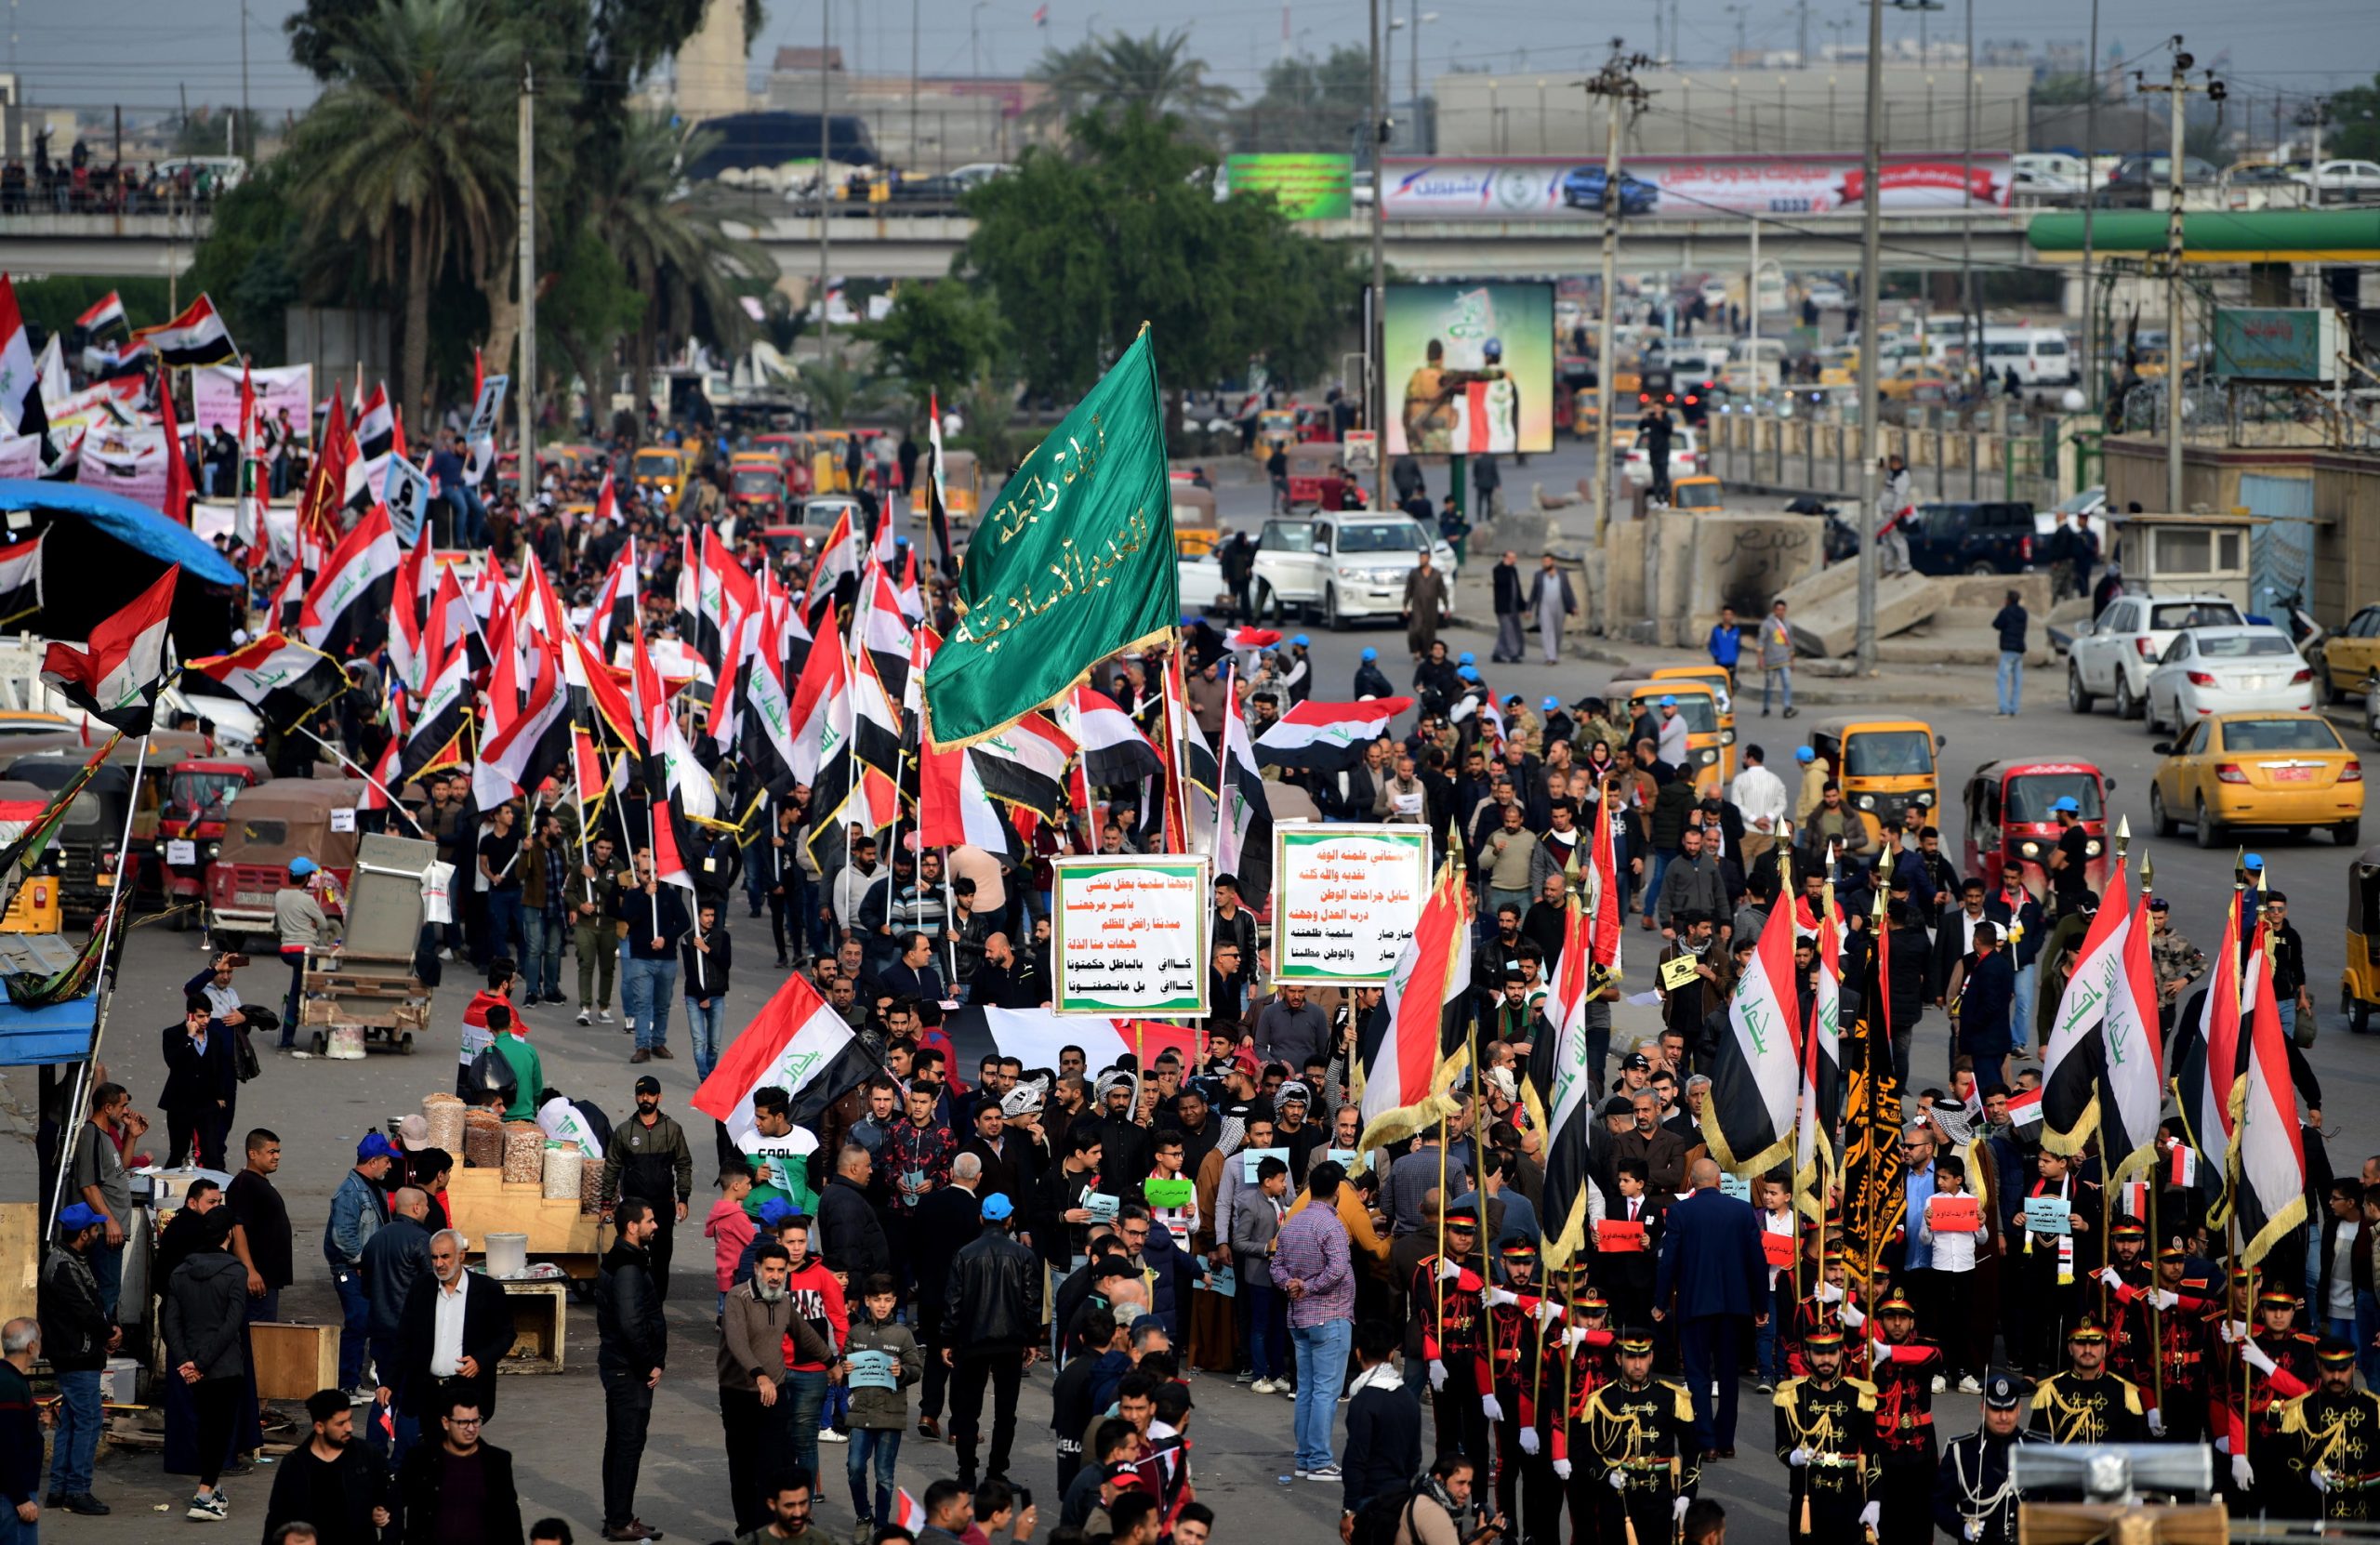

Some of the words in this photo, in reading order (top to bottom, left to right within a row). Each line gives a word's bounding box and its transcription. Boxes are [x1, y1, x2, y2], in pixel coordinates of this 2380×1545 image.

[1320, 868, 1339, 882] والله
[1086, 878, 1111, 894] نمشي
[1114, 879, 1134, 891] بعقل
[1137, 878, 1164, 892] سلمية
[1320, 889, 1347, 903] الوطن
[1350, 889, 1384, 904] جراحات
[1321, 909, 1346, 922] العدل
[1350, 909, 1368, 923] درب
[1102, 918, 1125, 933] للظلم
[1128, 918, 1150, 931] رافض
[1325, 928, 1353, 940] سلمية
[1377, 930, 1394, 941] صار
[1067, 939, 1088, 950] الذلة
[1091, 939, 1104, 949] منا
[1107, 939, 1136, 952] هيهات
[1291, 947, 1320, 958] مطلبنا
[1324, 948, 1355, 961] والوطن
[1379, 949, 1395, 961] صار
[1067, 959, 1105, 971] حكمتونا
[1109, 959, 1144, 971] بالباطل
